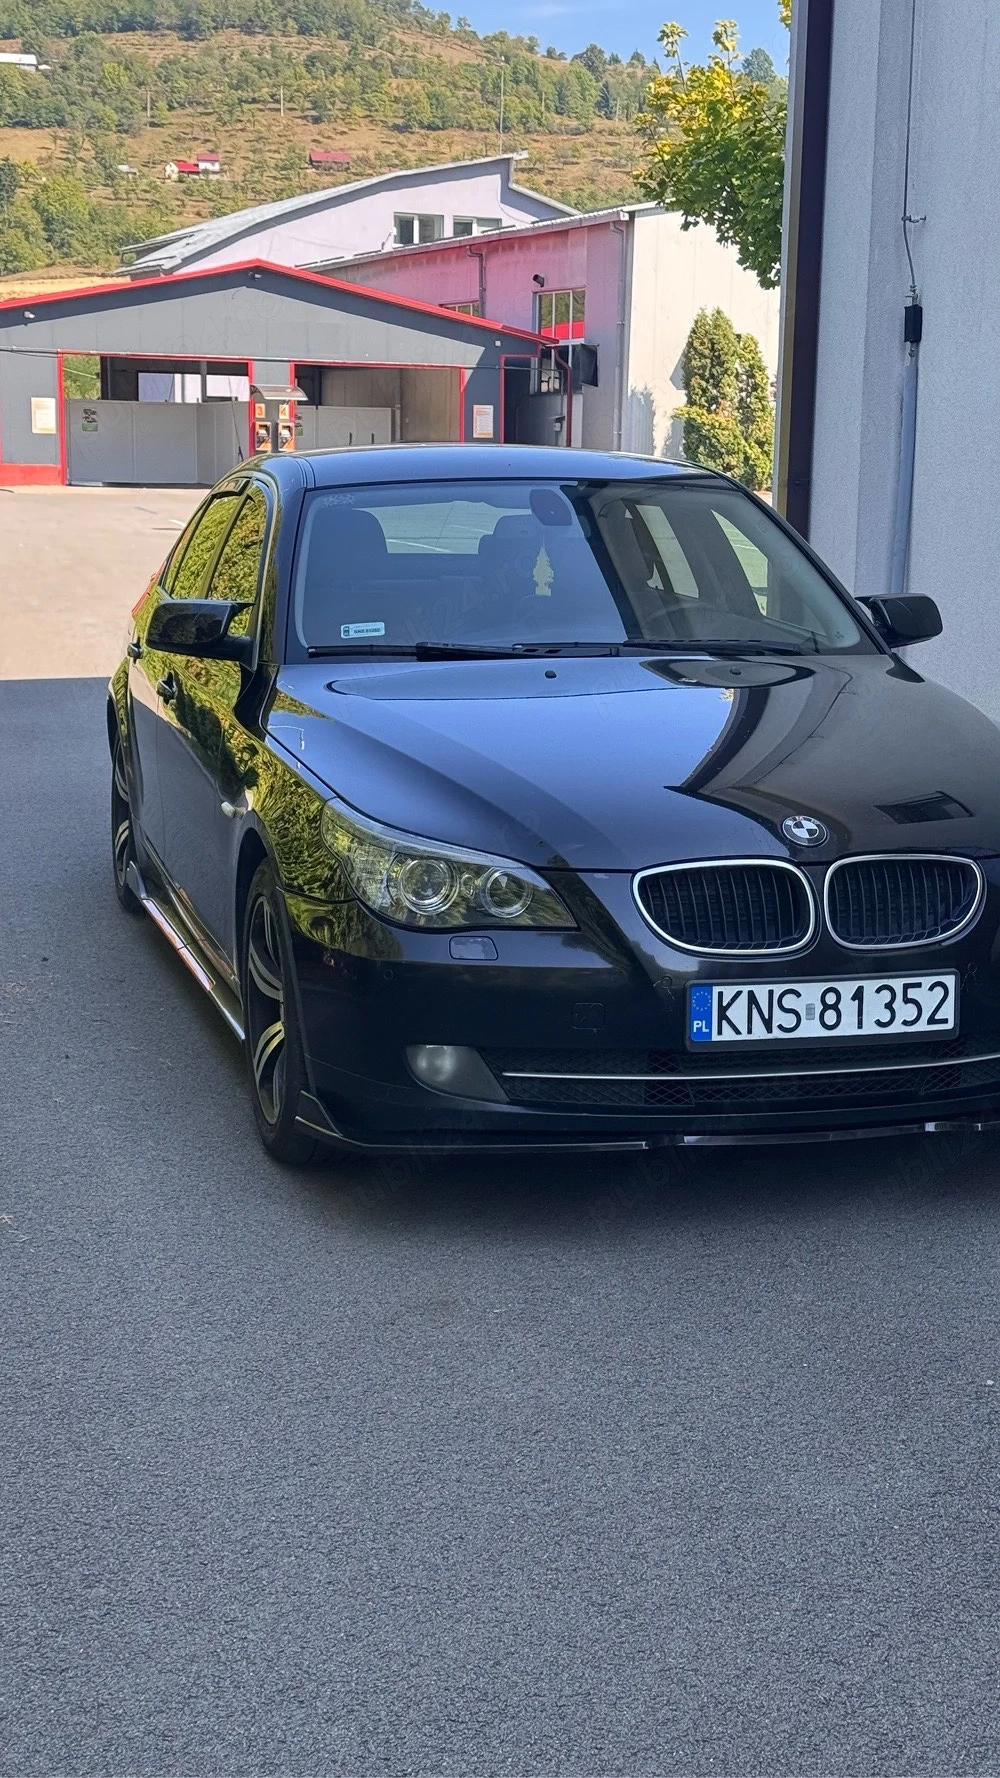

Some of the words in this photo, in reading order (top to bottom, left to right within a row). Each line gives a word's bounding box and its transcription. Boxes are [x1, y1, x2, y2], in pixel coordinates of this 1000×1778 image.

[257, 406, 263, 416] 3
[280, 406, 287, 416] 4
[717, 988, 802, 1035] KNS
[818, 980, 950, 1031] 81352
[693, 1020, 710, 1033] PL
